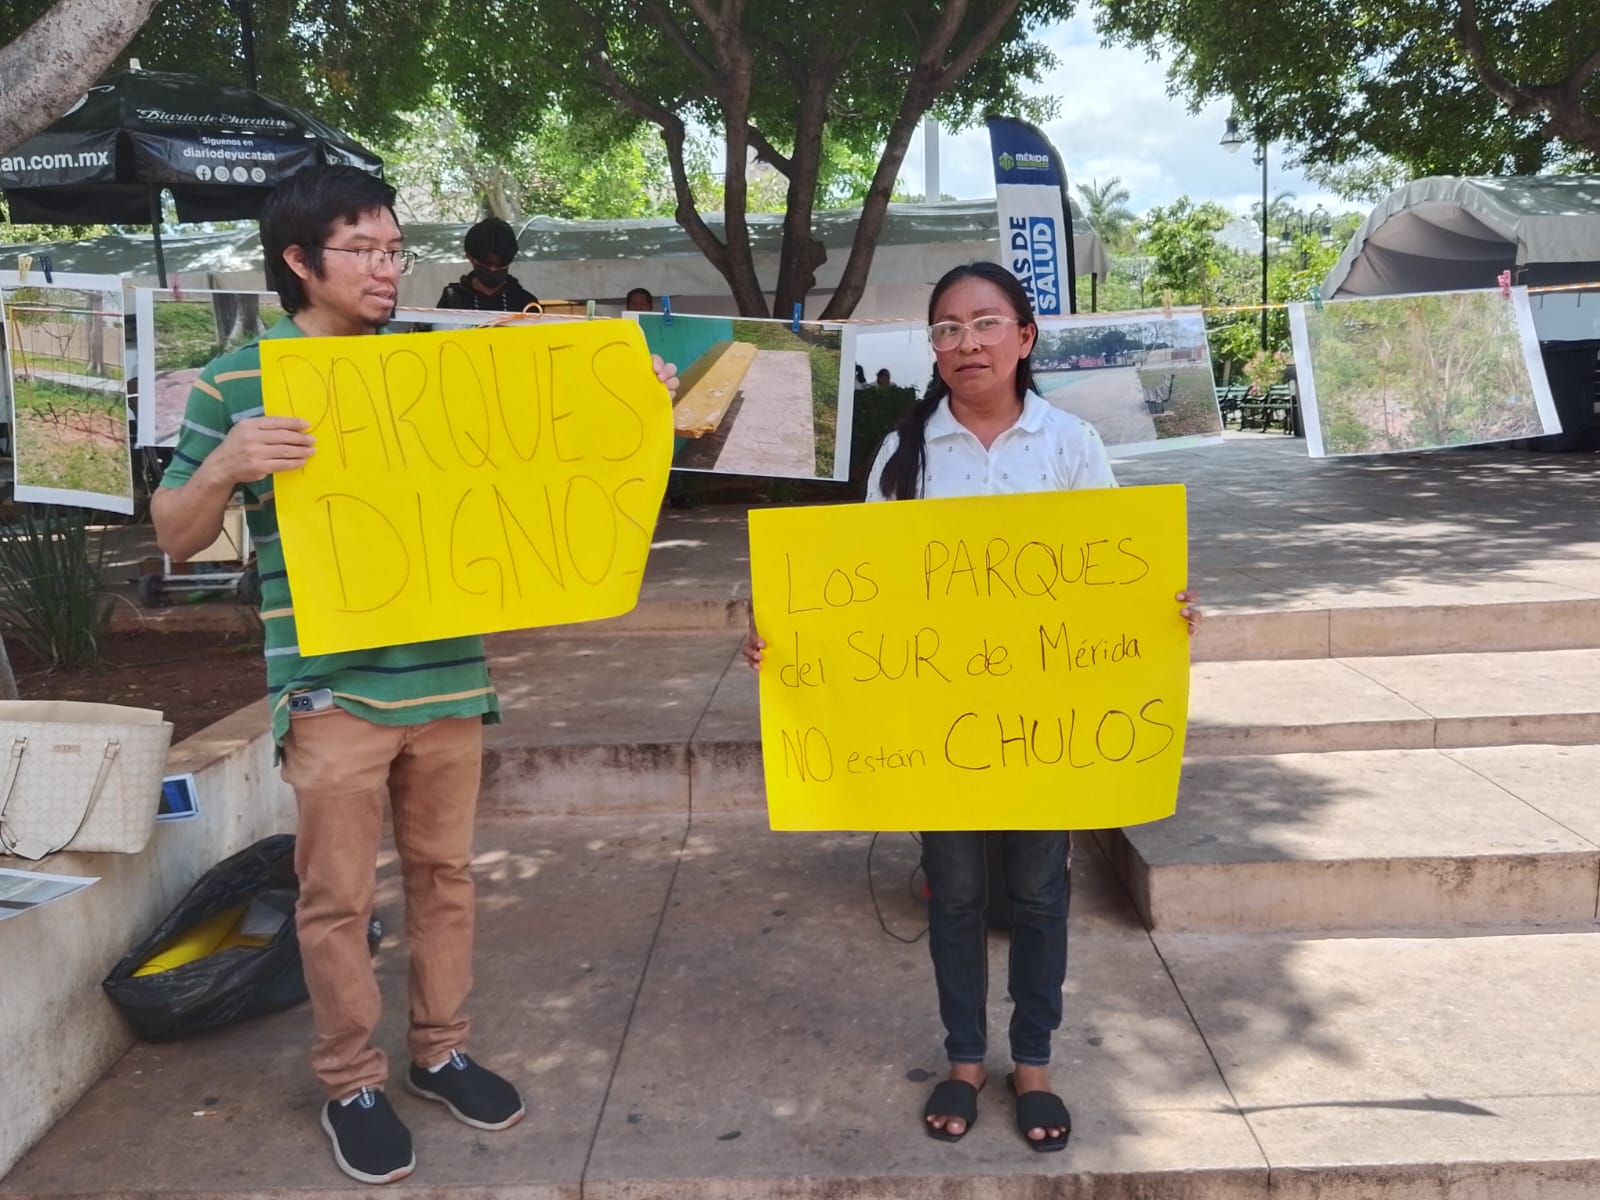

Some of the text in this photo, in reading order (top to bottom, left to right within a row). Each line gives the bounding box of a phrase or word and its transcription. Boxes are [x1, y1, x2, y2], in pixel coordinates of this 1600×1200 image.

[136, 108, 197, 123] Diario
[199, 112, 218, 123] de
[242, 138, 254, 147] en
[0, 150, 110, 172] an.com.mx
[183, 146, 276, 162] diariodeyucatan
[1009, 216, 1029, 251] DE
[1032, 222, 1057, 310] SALUD
[276, 339, 645, 475] PARQUES
[315, 474, 651, 613] DIGNOS
[923, 537, 1150, 601] PARQUES
[779, 621, 1142, 688] del SUR de Mérida
[781, 698, 1175, 783] NO están CHULOS
